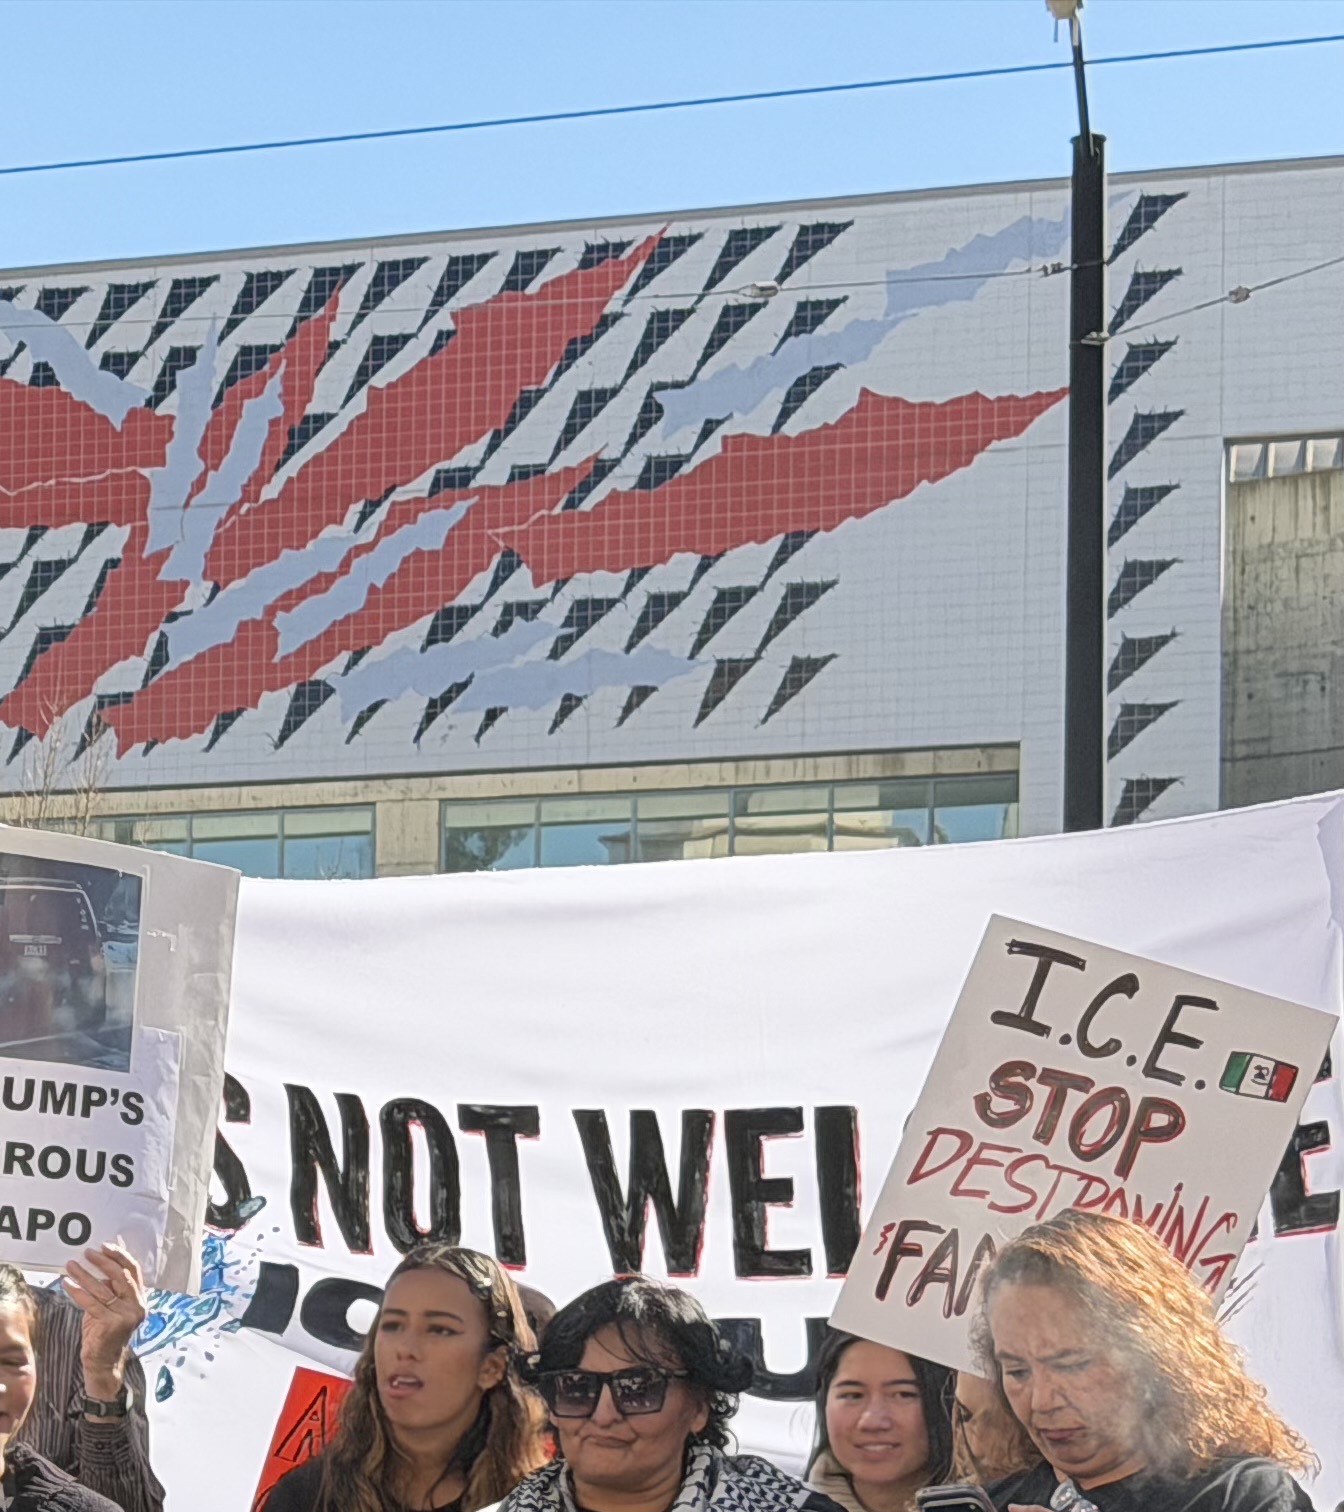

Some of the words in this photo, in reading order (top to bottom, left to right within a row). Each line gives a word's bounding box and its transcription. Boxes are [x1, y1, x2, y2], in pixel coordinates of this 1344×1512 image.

[990, 939, 1220, 1091] I.C.E.
[283, 1080, 540, 1271] NOT
[973, 1060, 1187, 1181] STOP
